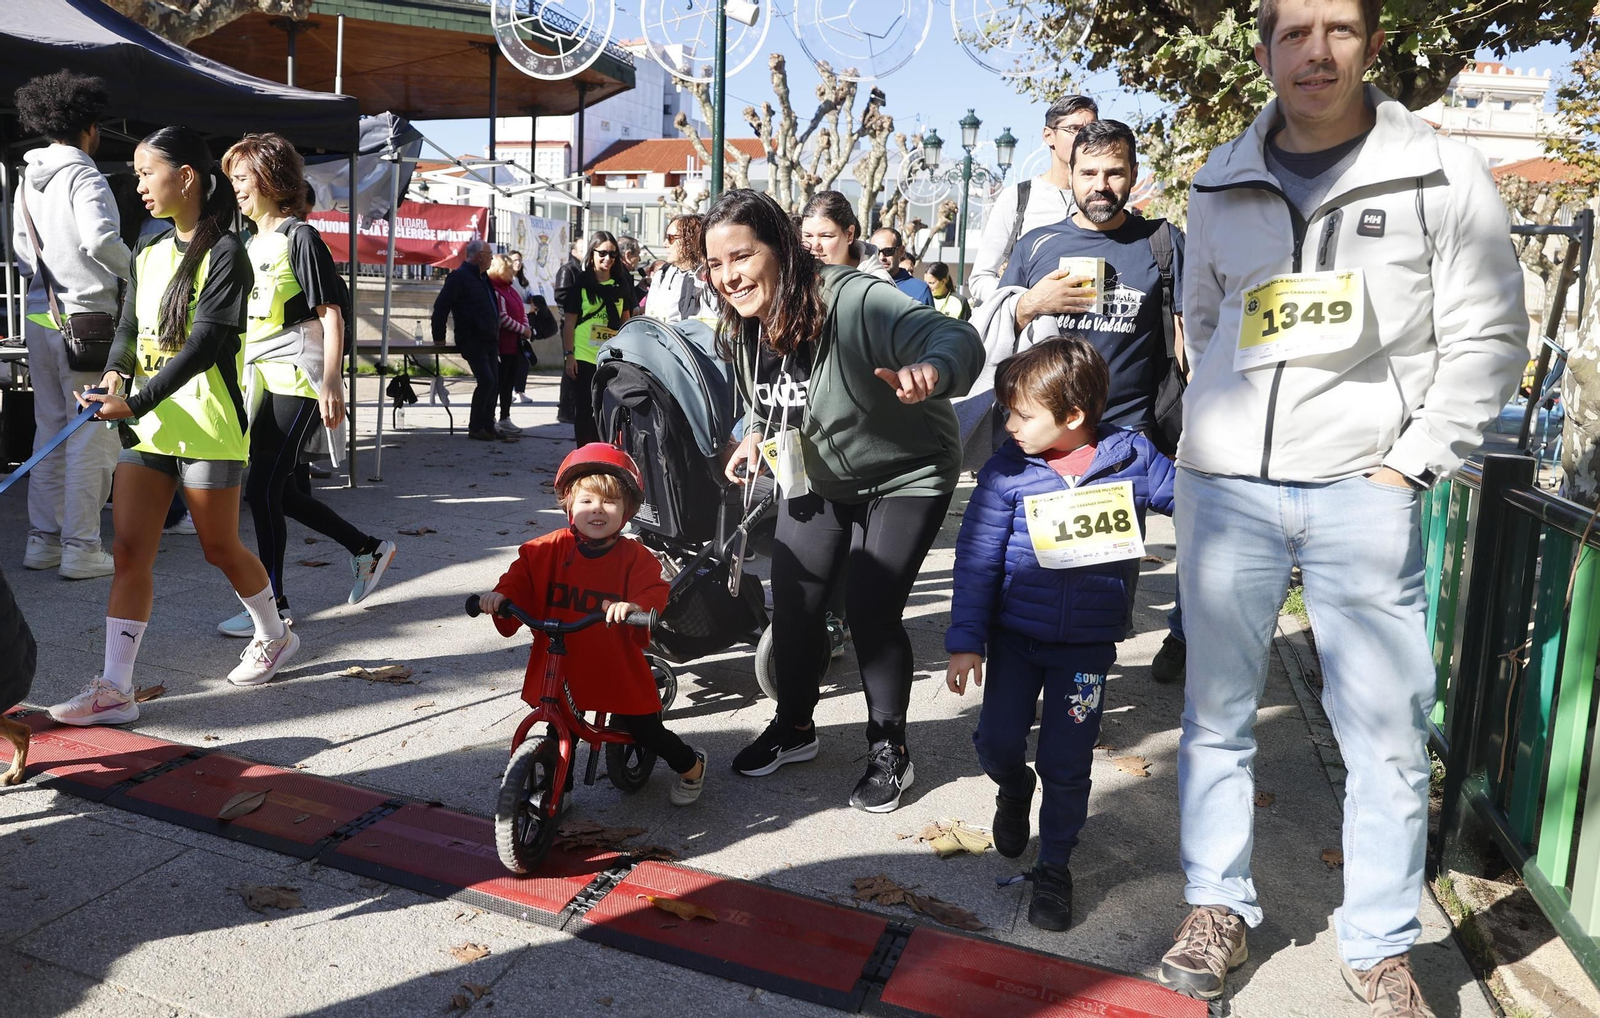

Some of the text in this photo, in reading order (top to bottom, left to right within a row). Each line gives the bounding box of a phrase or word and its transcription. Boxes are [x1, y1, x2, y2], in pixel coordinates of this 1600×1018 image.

[308, 218, 350, 234] MÓVOM
[382, 225, 436, 240] ECLEROSE
[1364, 215, 1382, 224] HH
[1077, 314, 1093, 330] de
[1261, 300, 1353, 338] 1349
[1052, 508, 1131, 542] 1348
[1073, 671, 1104, 685] SONIC
